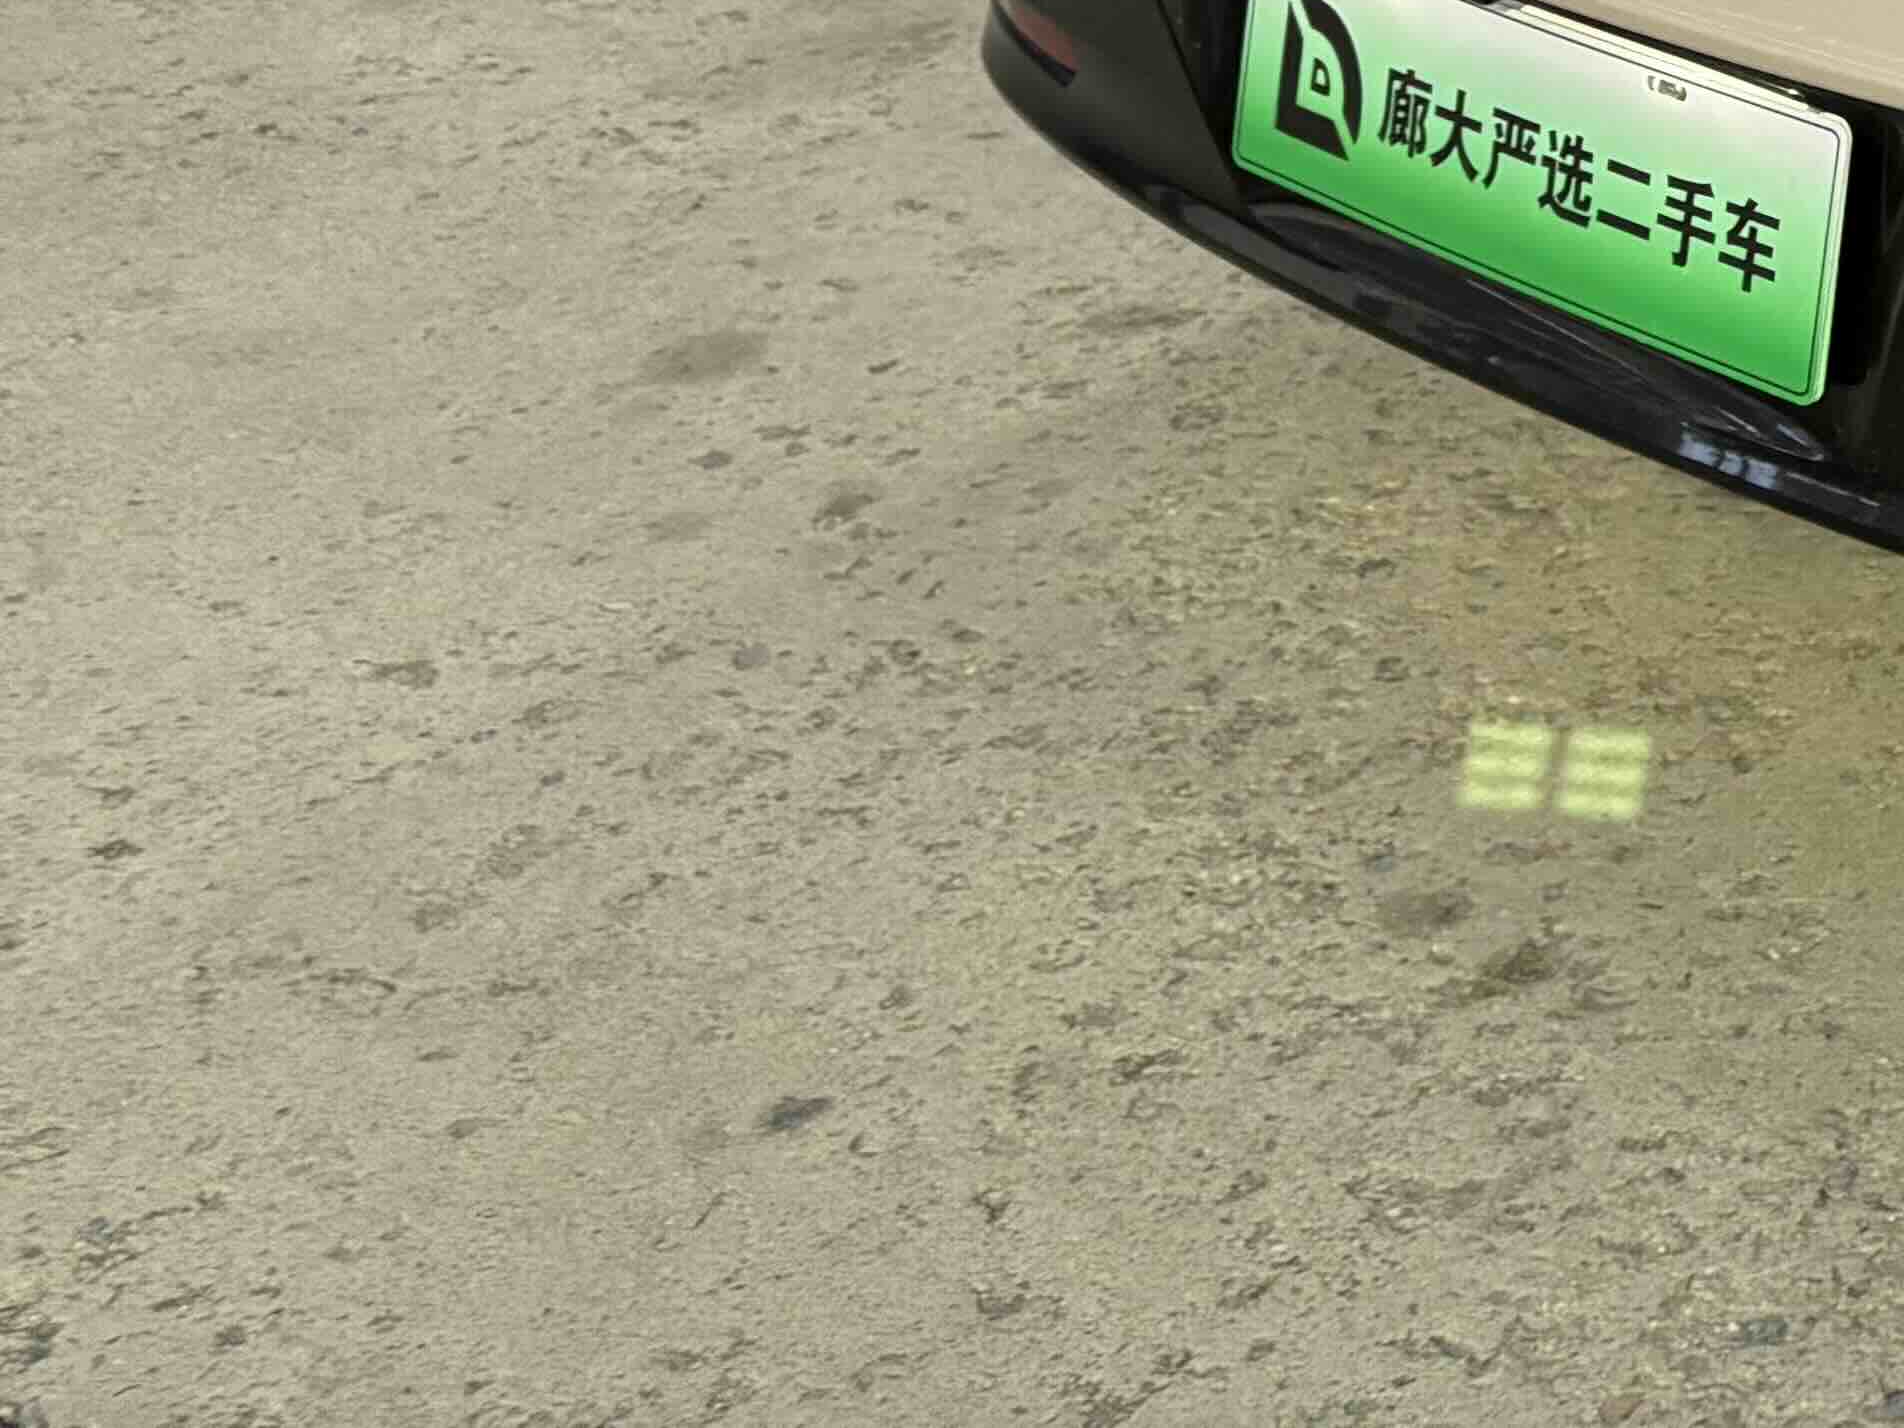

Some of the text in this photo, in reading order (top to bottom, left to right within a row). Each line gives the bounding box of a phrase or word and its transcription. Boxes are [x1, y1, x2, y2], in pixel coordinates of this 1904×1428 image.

[1377, 67, 1781, 294] 廊大严选二手车
